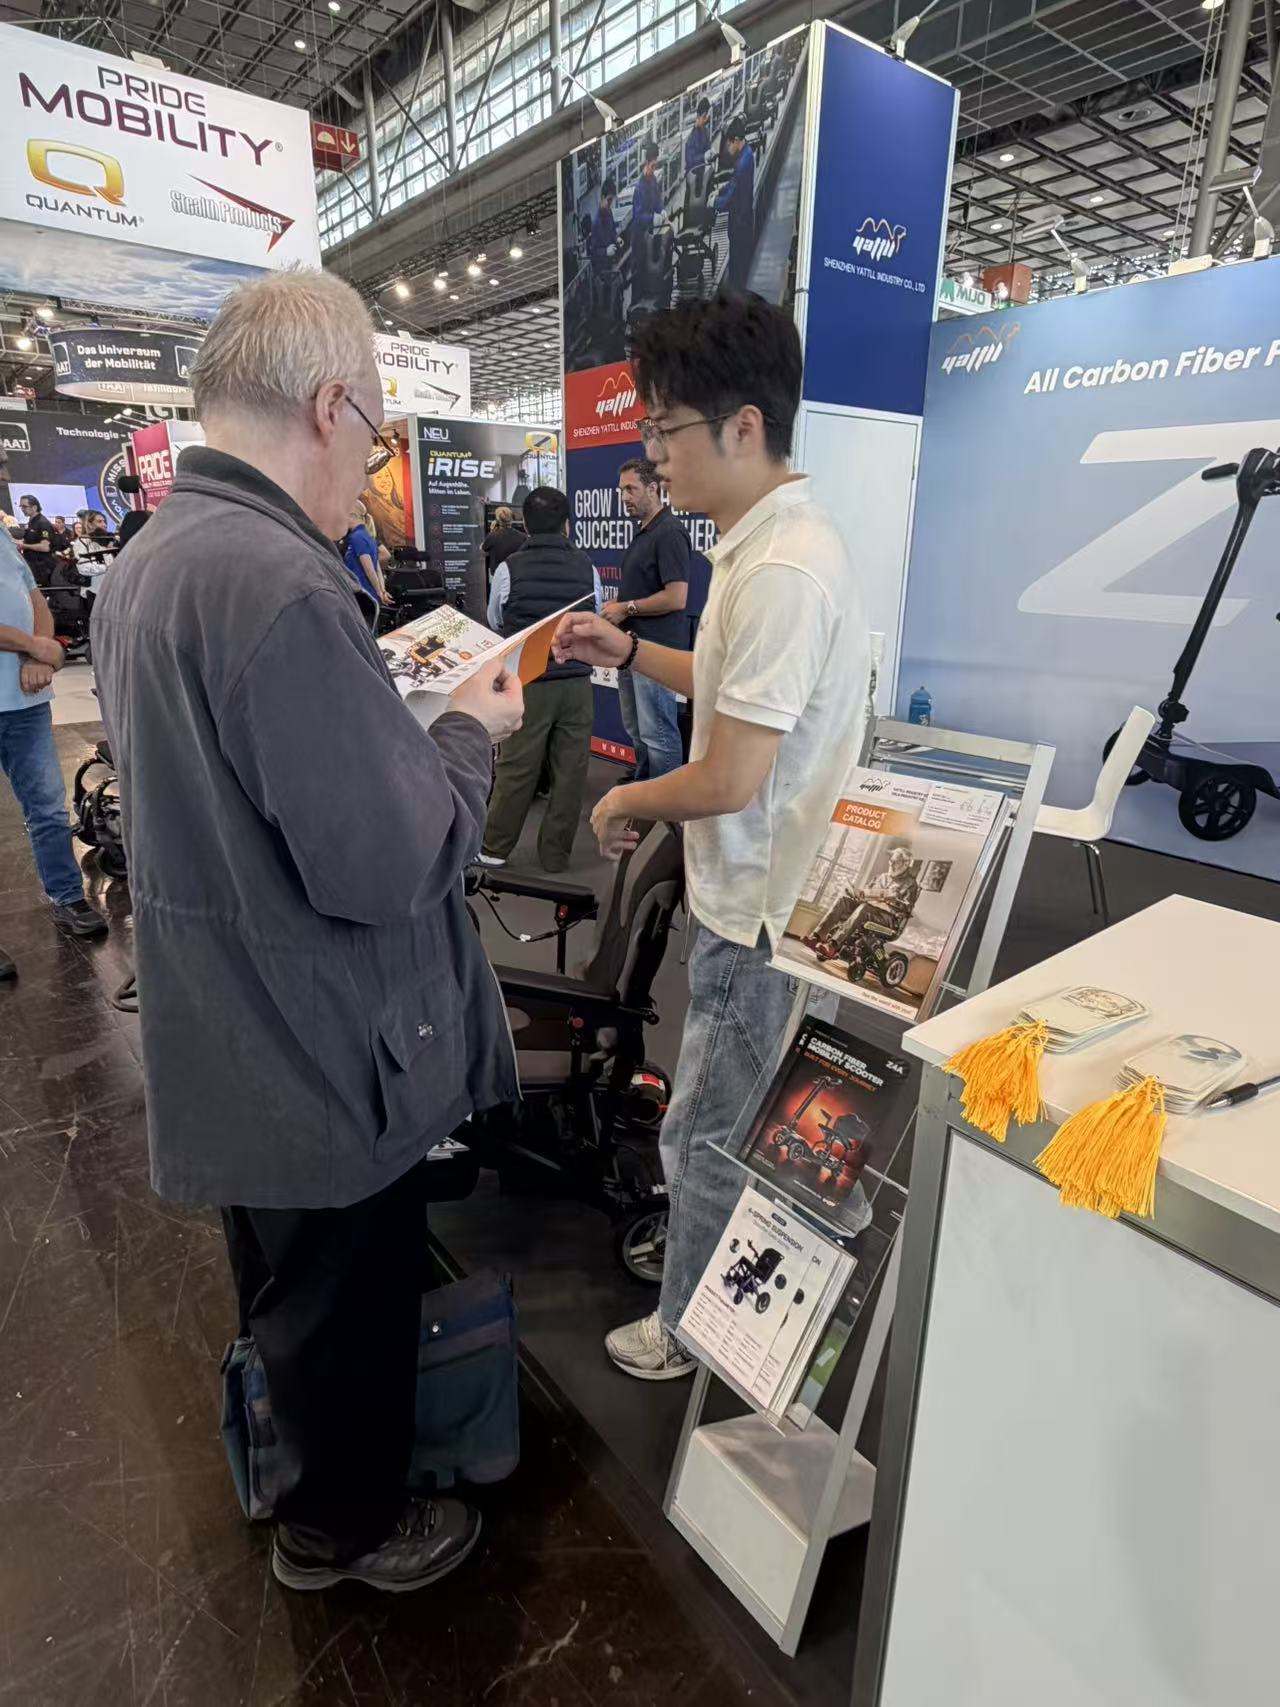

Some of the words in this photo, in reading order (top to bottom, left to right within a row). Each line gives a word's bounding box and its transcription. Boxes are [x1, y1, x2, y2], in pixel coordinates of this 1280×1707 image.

[97, 65, 206, 117] PRIDE
[18, 71, 273, 166] MOBILITY
[25, 193, 139, 227] QUANTUM
[824, 257, 856, 274] SHENZHEN
[876, 271, 903, 286] INDUSTRY
[76, 344, 97, 356] Das
[99, 345, 161, 358] Universum
[390, 342, 430, 357] PRIDE
[84, 358, 103, 369] der
[105, 359, 156, 371] Mobilität
[1023, 367, 1060, 394] All
[1063, 354, 1169, 390] Carbon
[1175, 345, 1262, 378] Fiber
[56, 427, 119, 441] Technologie
[424, 426, 449, 440] NEU
[620, 420, 638, 430] INDUS
[138, 449, 173, 481] PRIDE
[430, 450, 469, 458] QUANTUM
[428, 457, 496, 479] iRISE
[575, 488, 612, 518] GROW
[575, 520, 633, 549] SUCCEED
[842, 812, 881, 830] CATALOG
[845, 803, 887, 819] PRODUCT
[807, 1043, 843, 1065] MOBILITY
[844, 1062, 884, 1087] SCOOTER
[810, 1037, 843, 1057] CARBON
[843, 1053, 867, 1070] FIBER
